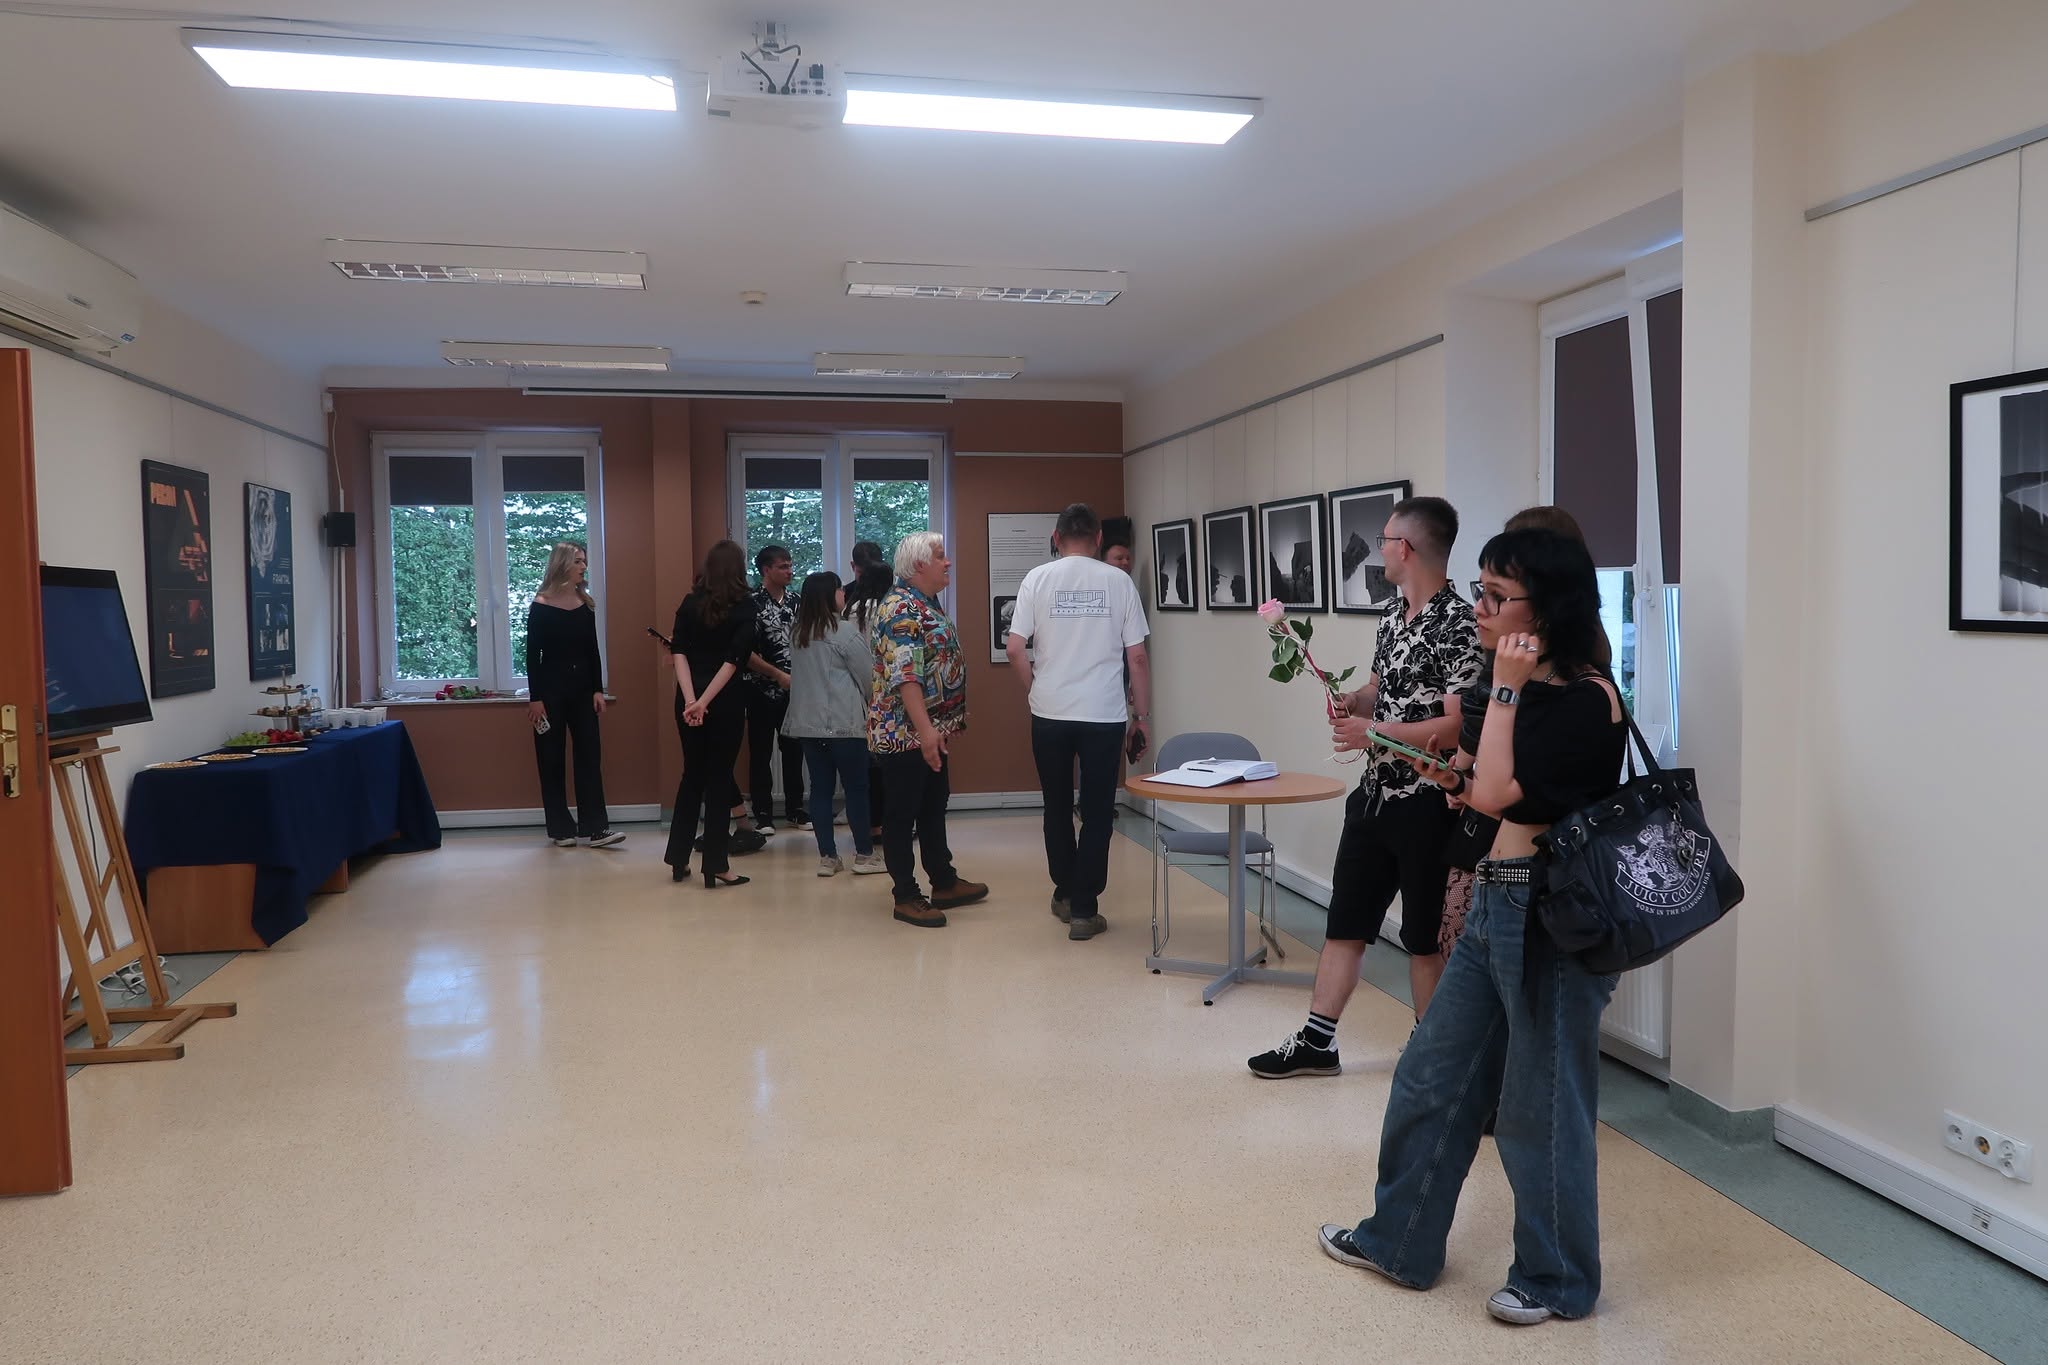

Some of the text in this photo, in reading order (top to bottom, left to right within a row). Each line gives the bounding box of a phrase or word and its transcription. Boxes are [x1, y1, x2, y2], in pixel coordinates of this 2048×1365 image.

[1624, 848, 1707, 904] JUICY COUTURE
[1635, 902, 1656, 914] BORN
[1656, 908, 1664, 916] IN
[1666, 908, 1680, 916] THE
